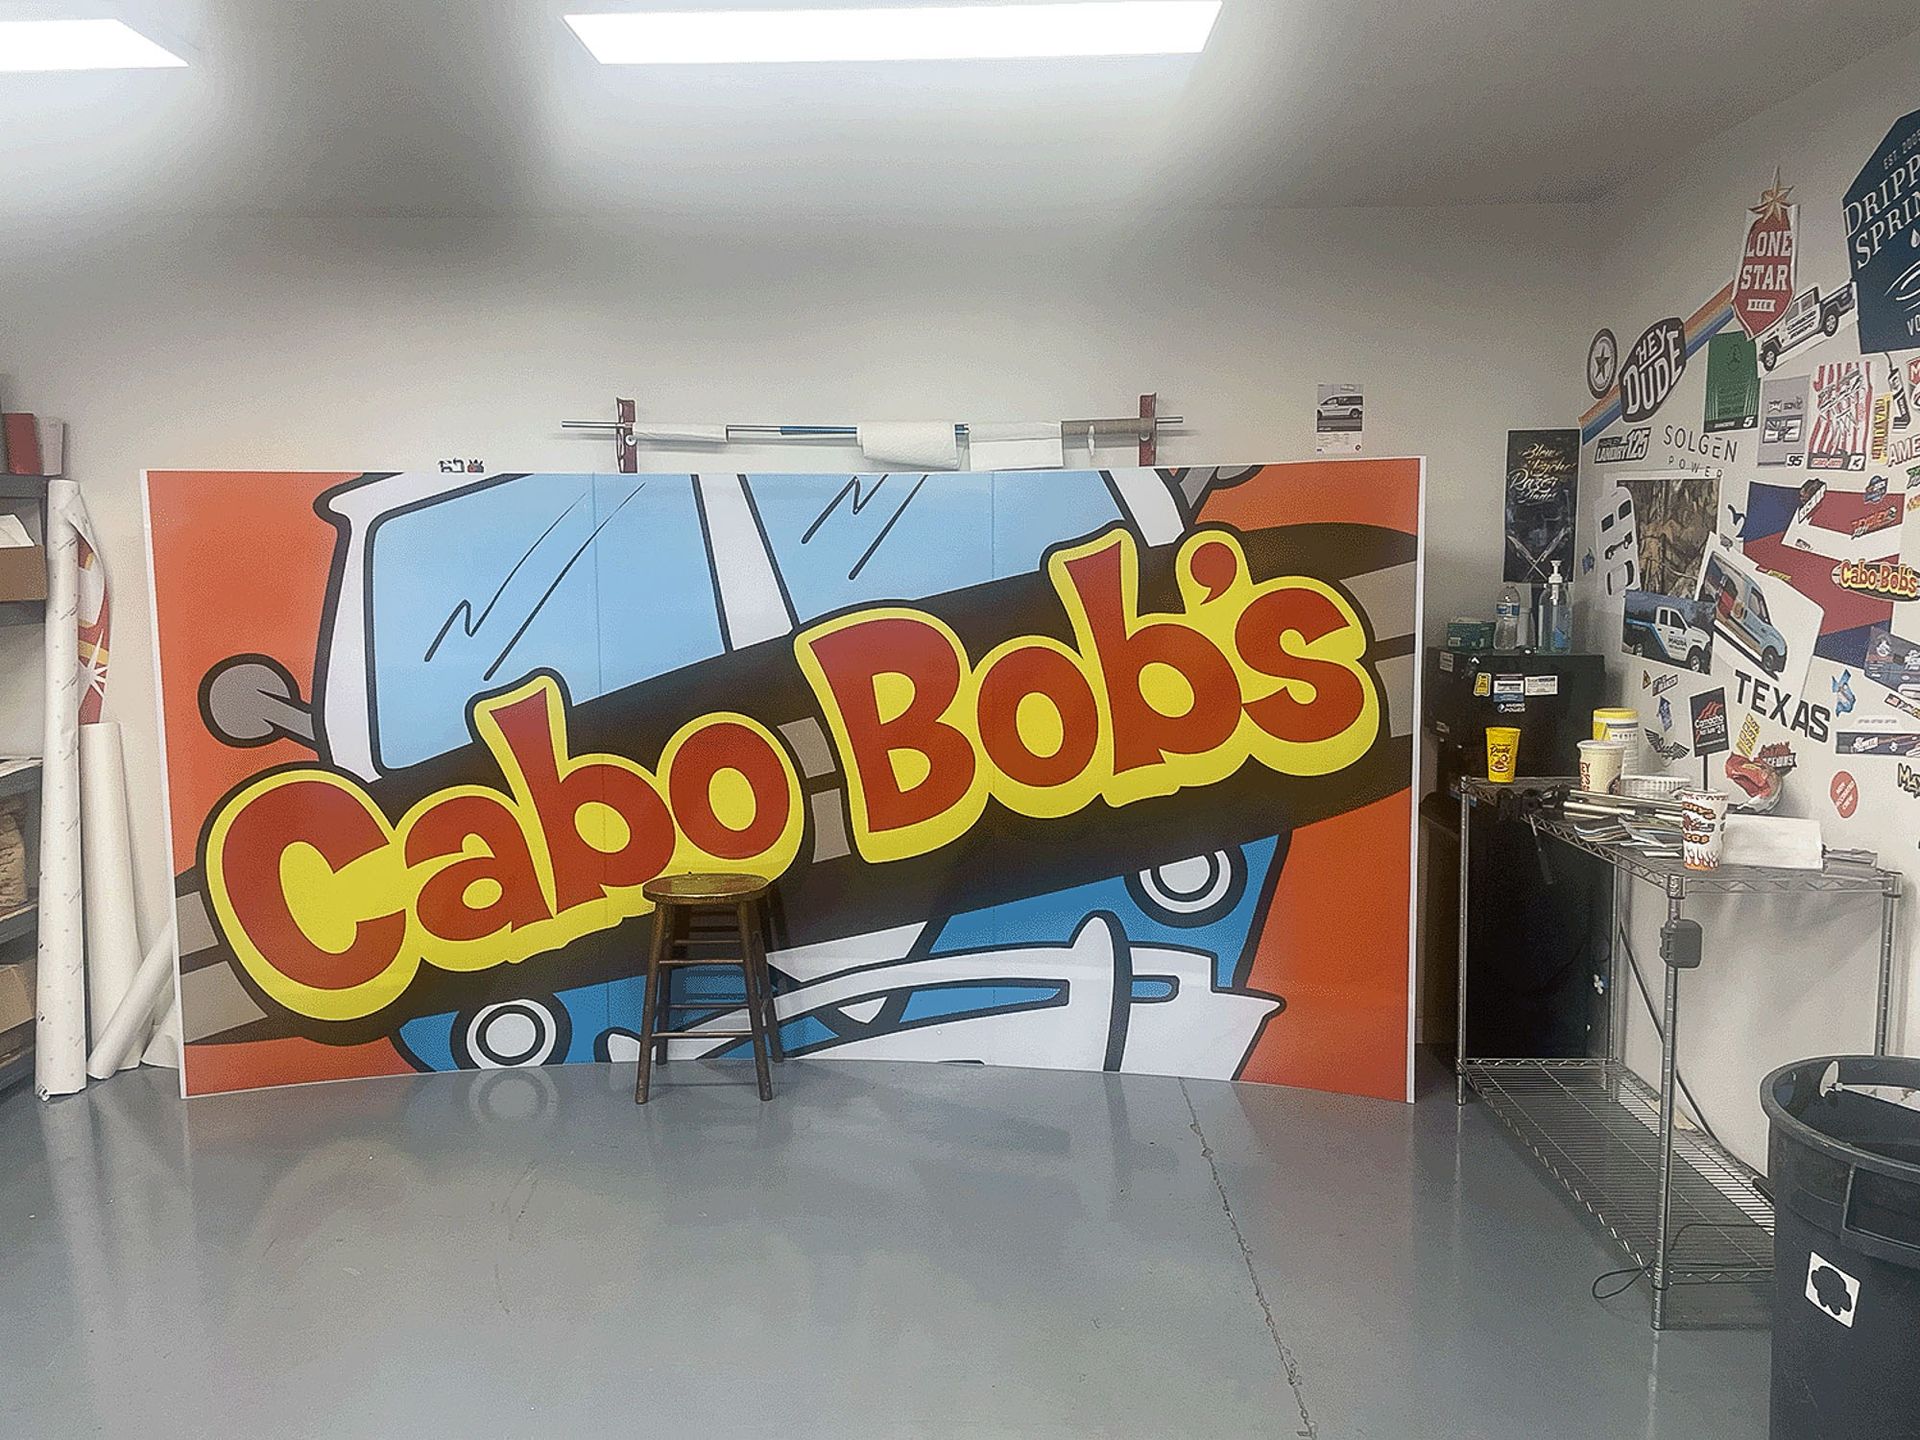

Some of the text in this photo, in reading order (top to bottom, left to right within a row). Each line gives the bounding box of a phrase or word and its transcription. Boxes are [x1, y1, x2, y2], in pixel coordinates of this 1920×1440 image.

[1747, 230, 1792, 257] LONE
[1740, 264, 1788, 291] STAR
[1636, 324, 1667, 365] HEY
[1623, 331, 1683, 414] DUDE
[1743, 416, 1754, 428] 5
[1787, 455, 1803, 466] 95
[1839, 559, 1919, 595] Cabo Bob's
[1734, 669, 1830, 743] TEXAS
[206, 528, 1378, 1020] Cabo Bob's
